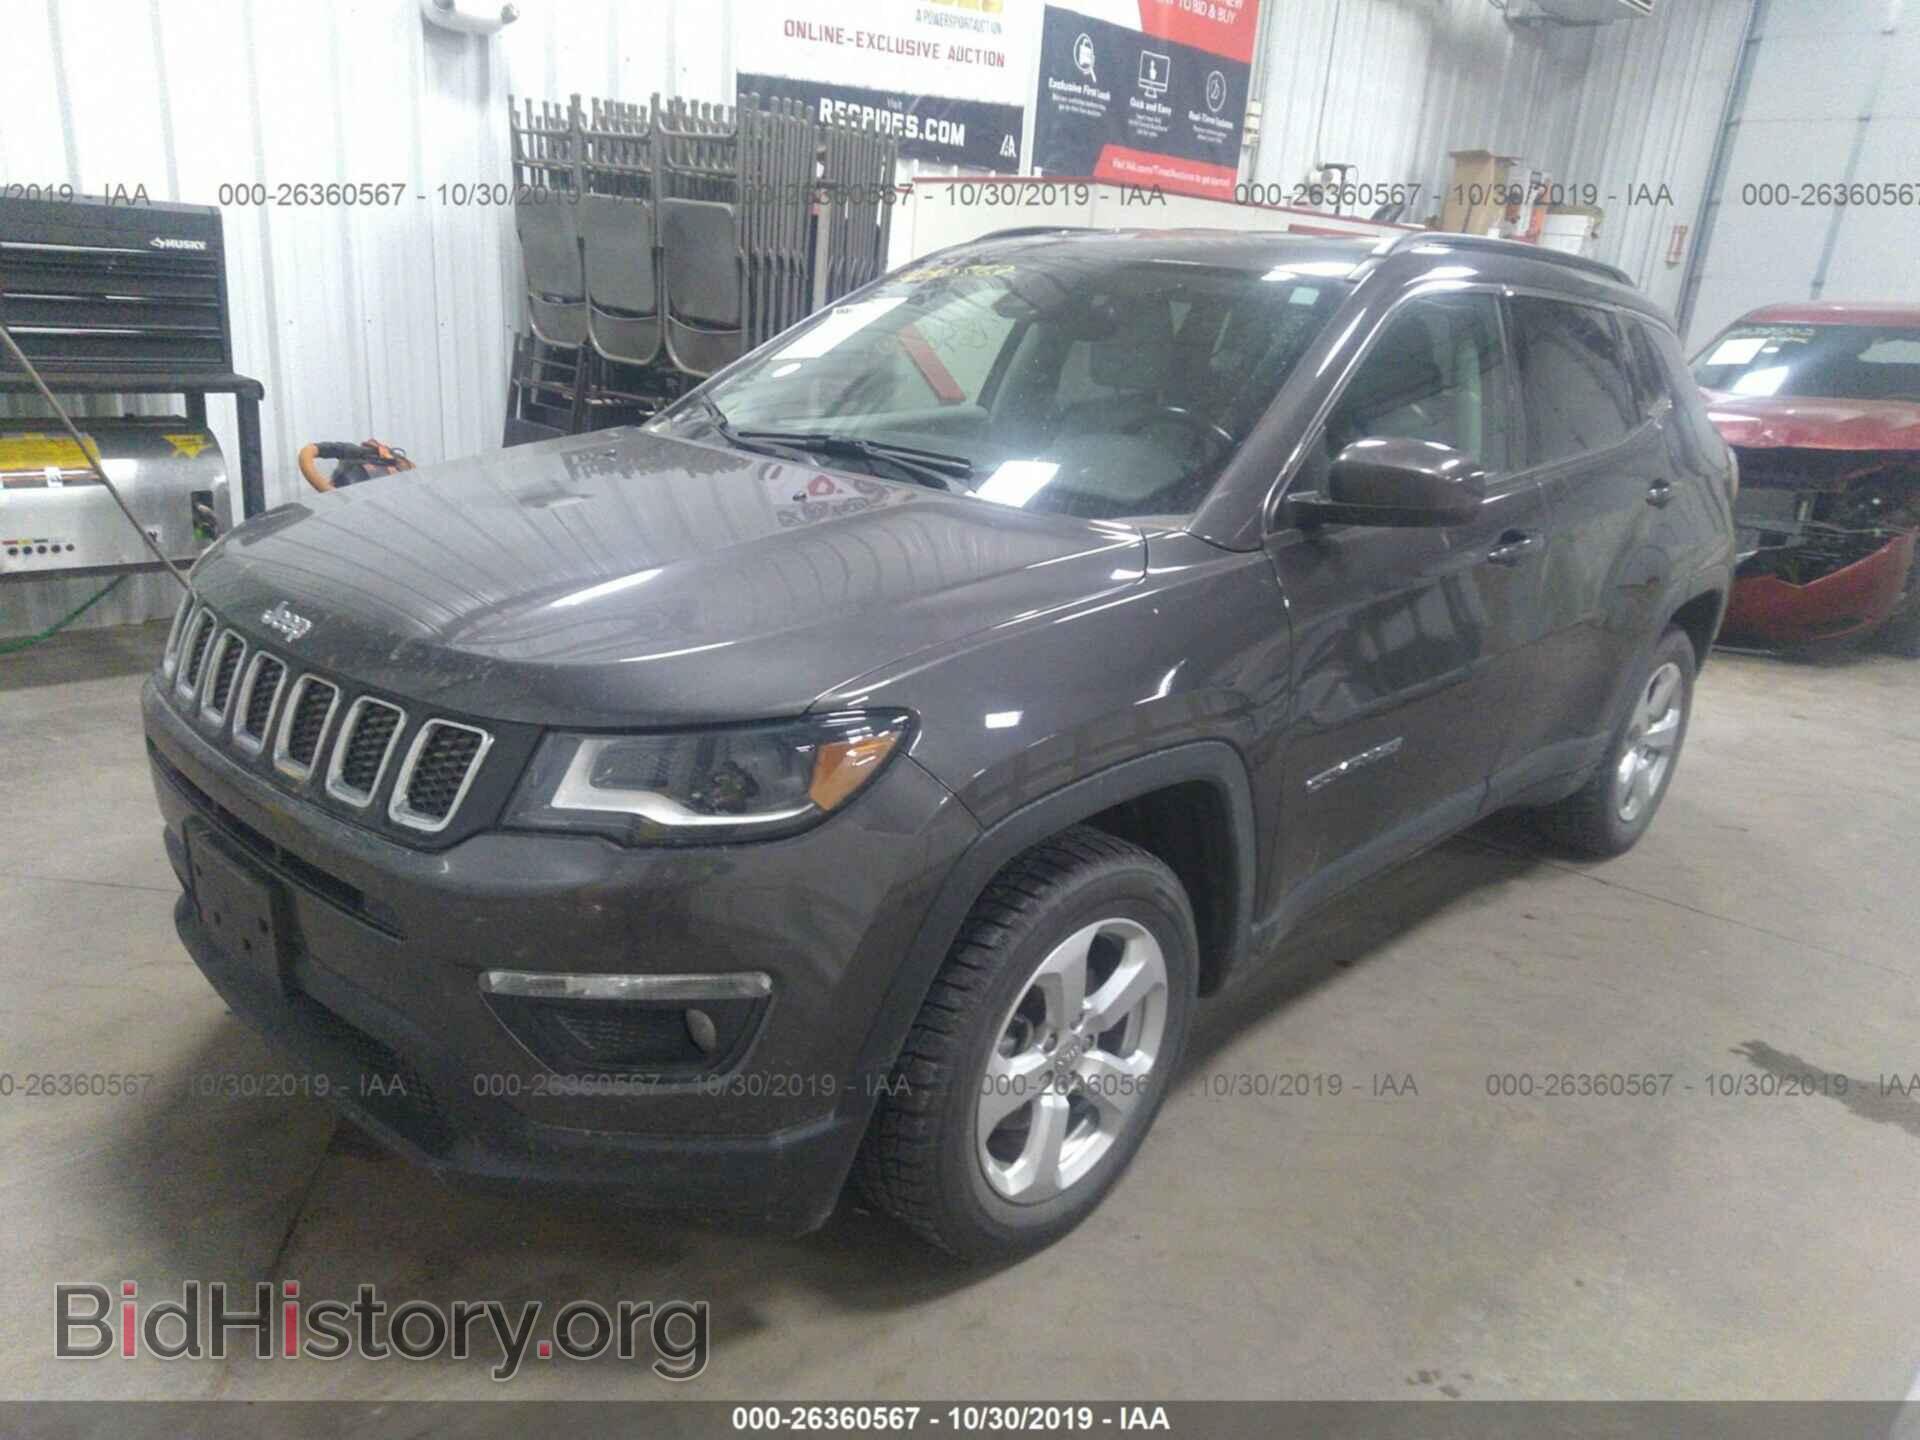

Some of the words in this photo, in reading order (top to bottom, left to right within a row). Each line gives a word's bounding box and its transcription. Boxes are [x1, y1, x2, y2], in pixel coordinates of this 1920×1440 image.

[1218, 8, 1237, 24] BUY
[784, 19, 941, 60] ONLINE-EXCLUSIVE
[947, 45, 1006, 68] AUCTION
